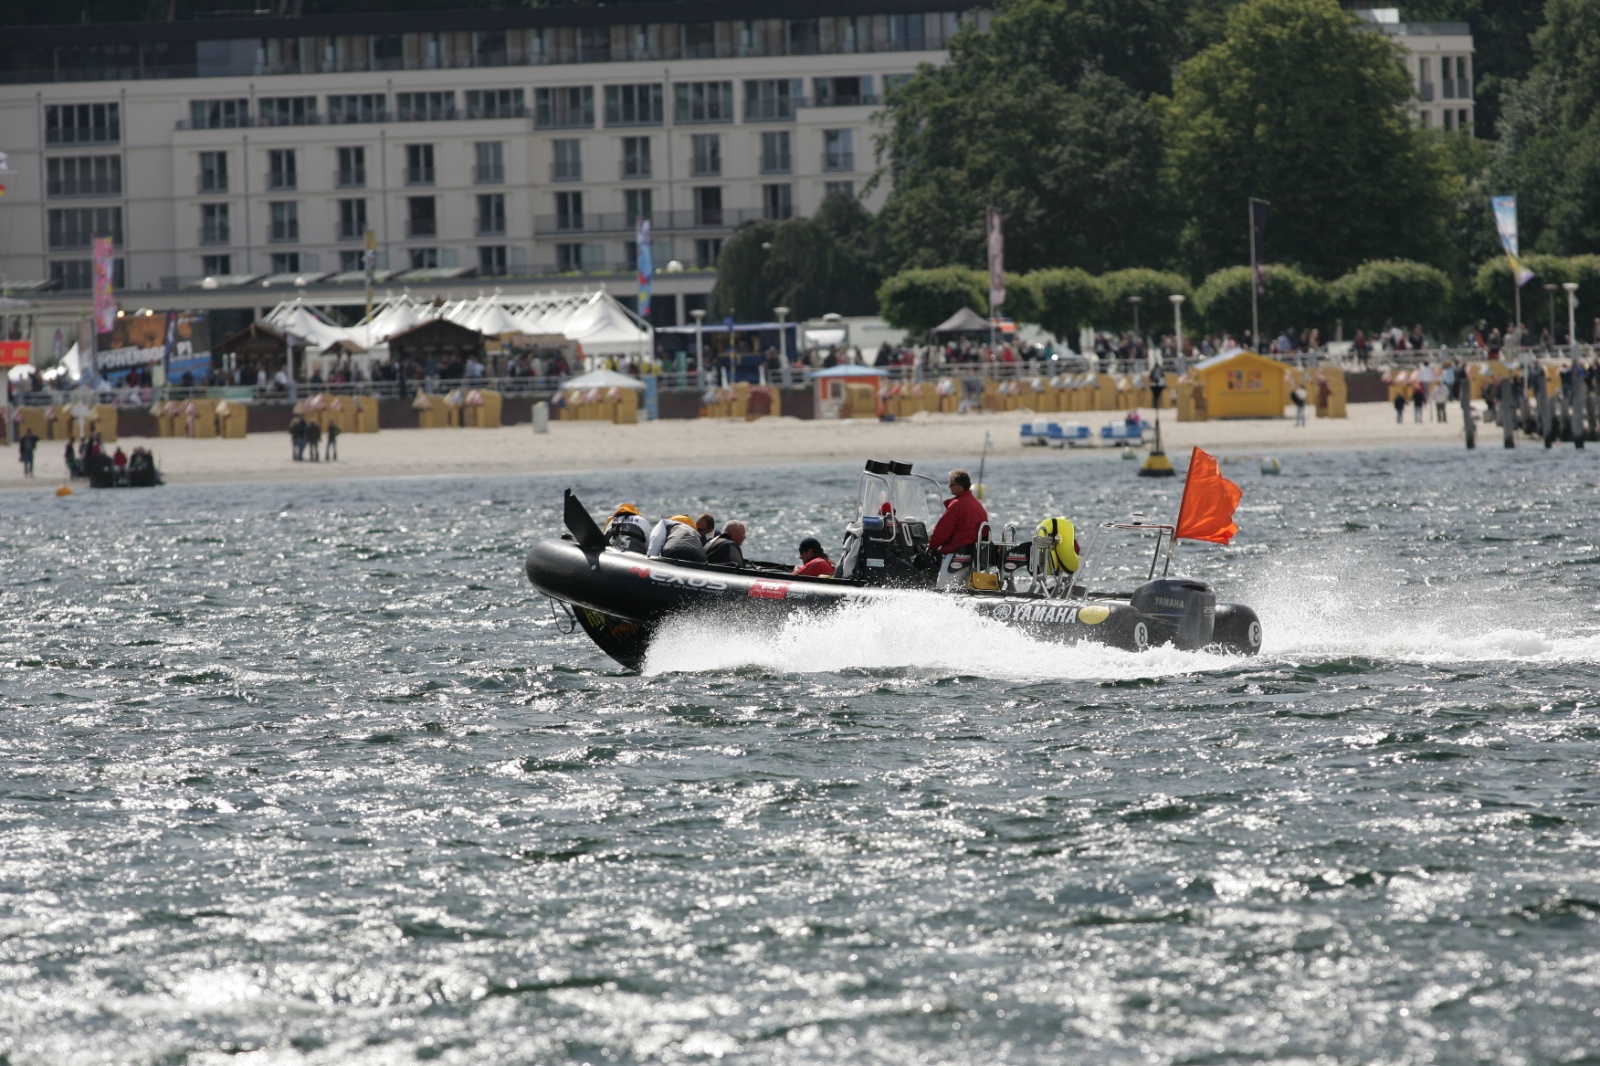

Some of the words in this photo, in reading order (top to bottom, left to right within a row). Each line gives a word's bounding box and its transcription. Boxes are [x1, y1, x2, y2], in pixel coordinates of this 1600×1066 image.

[629, 566, 728, 591] NEXUS
[1155, 597, 1185, 609] YAMAHA
[1014, 605, 1078, 623] YAMAHA
